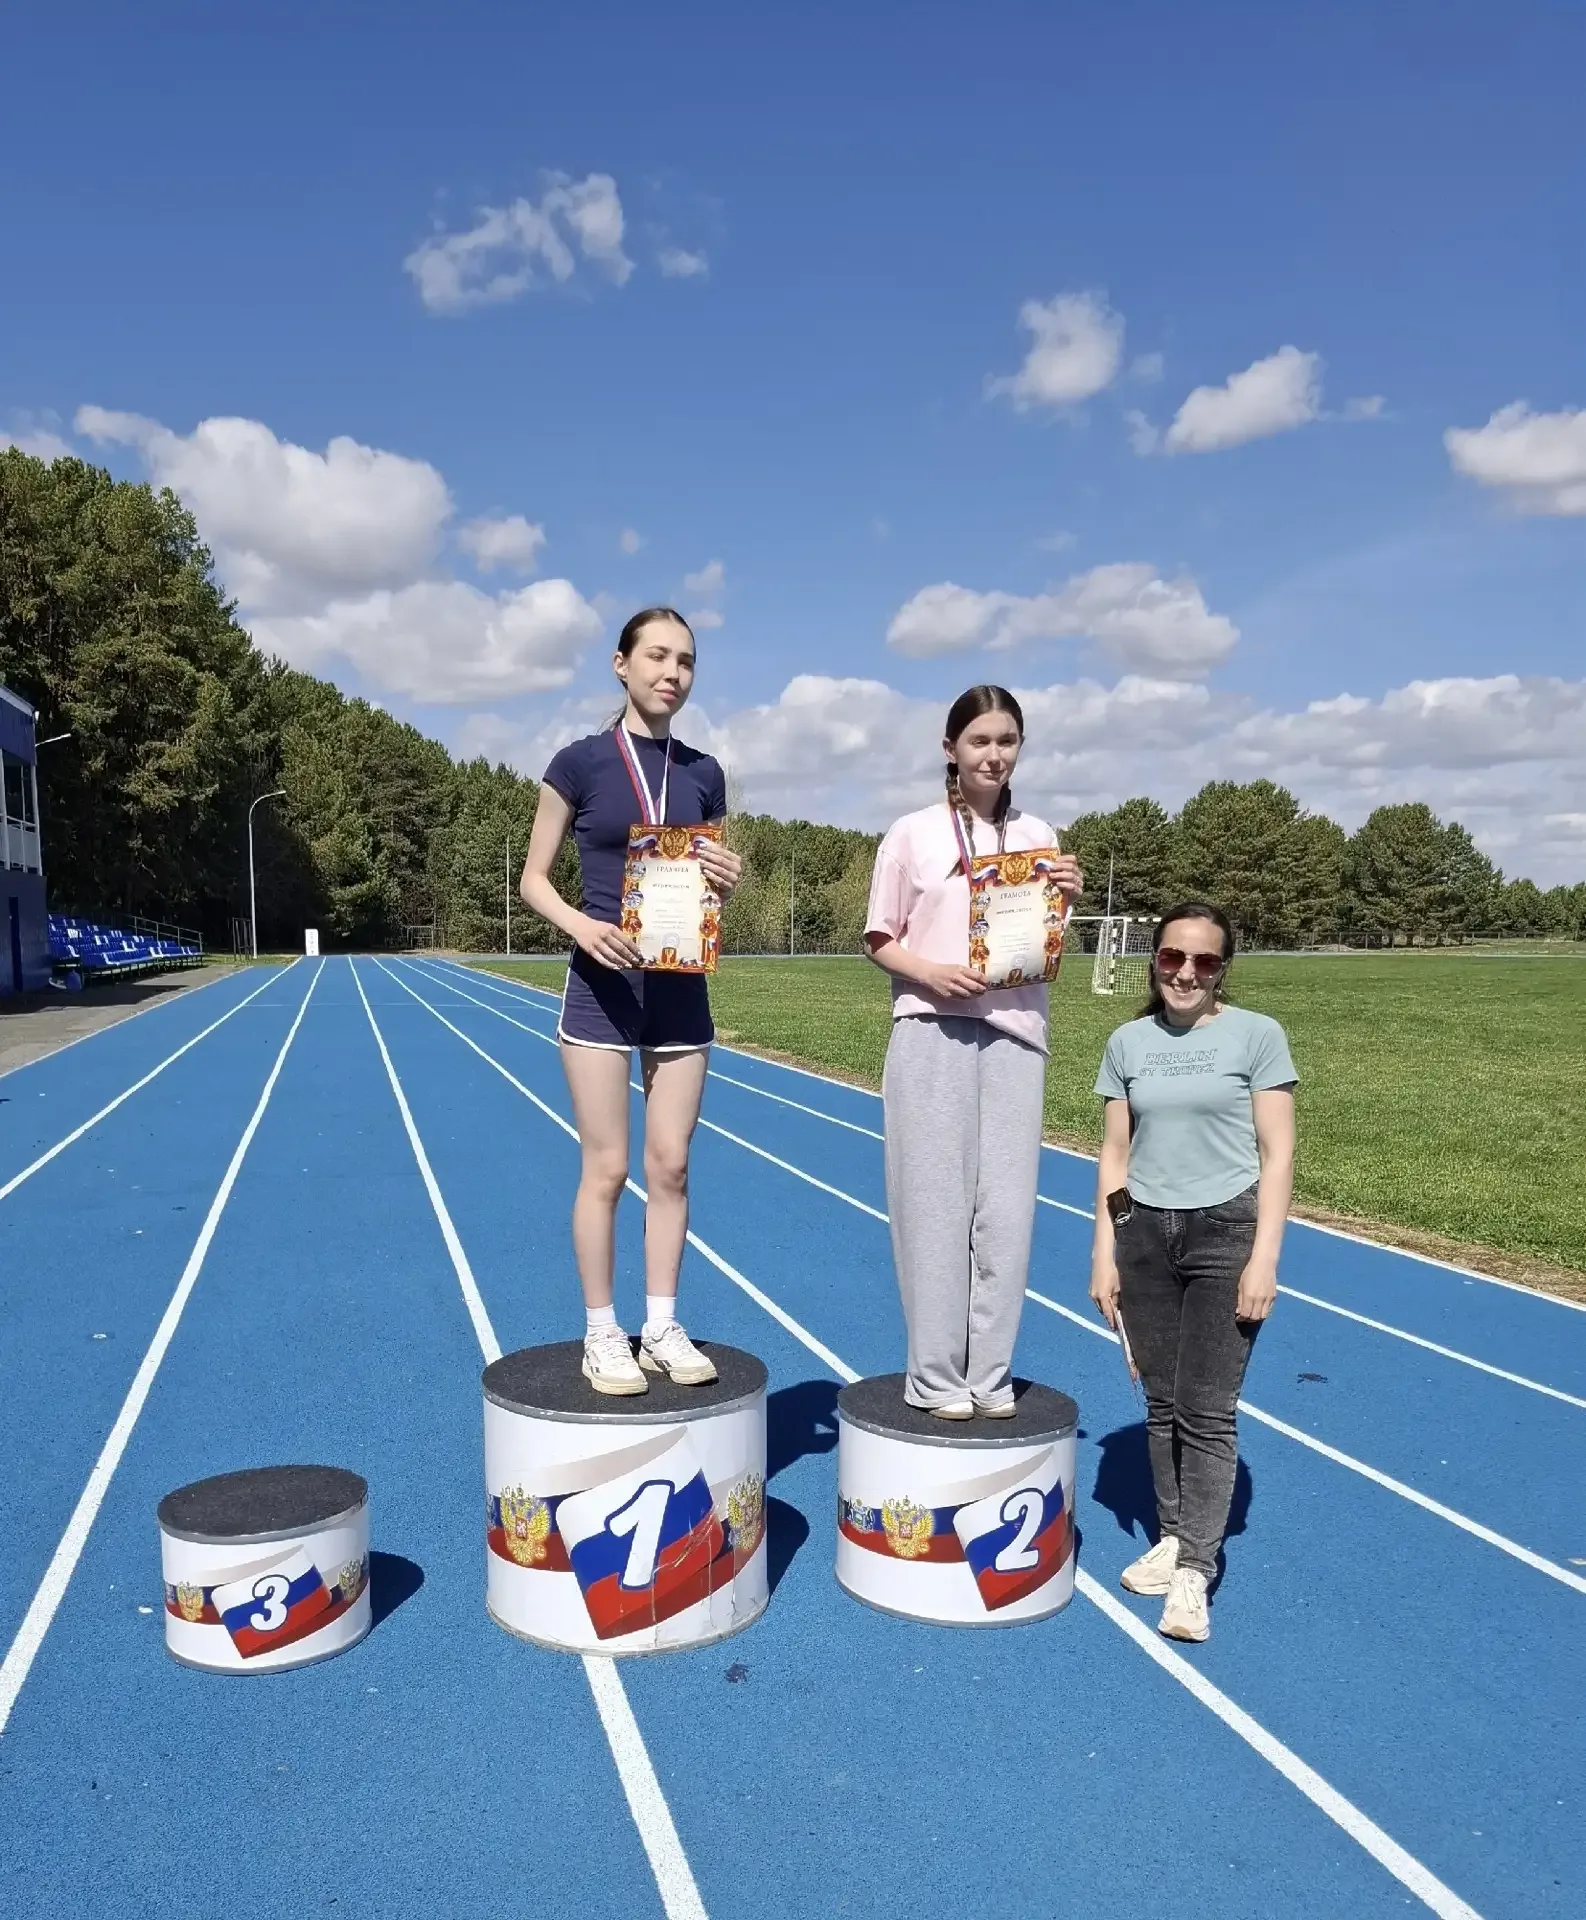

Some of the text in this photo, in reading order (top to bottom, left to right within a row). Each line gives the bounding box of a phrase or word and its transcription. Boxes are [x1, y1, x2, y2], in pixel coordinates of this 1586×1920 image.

[1144, 1048, 1218, 1065] BERLIN
[604, 1479, 675, 1592] 1
[995, 1487, 1044, 1574] 2
[249, 1574, 290, 1633] 3
